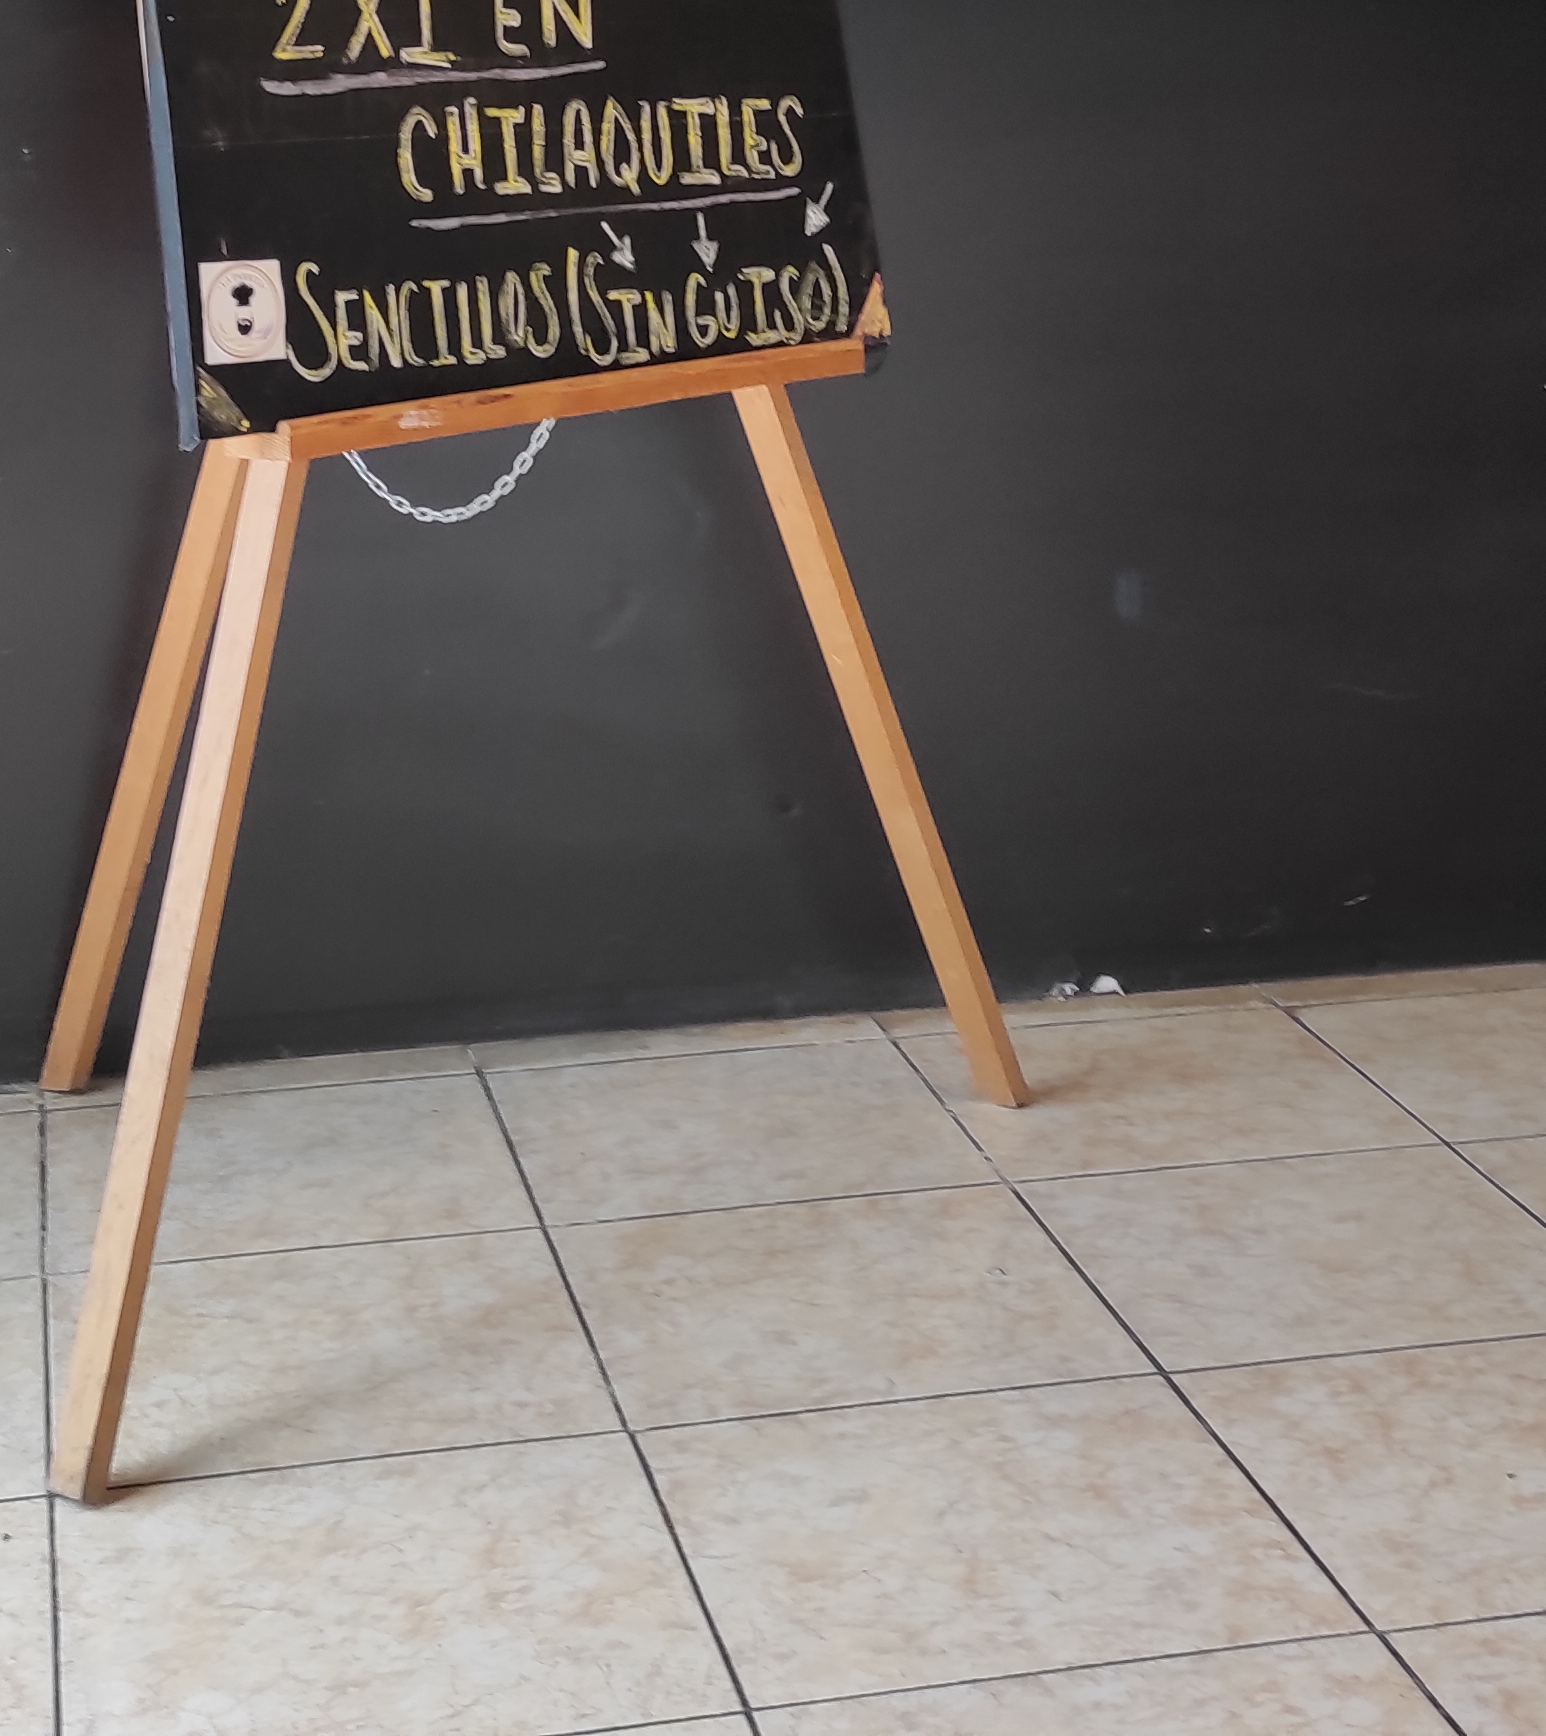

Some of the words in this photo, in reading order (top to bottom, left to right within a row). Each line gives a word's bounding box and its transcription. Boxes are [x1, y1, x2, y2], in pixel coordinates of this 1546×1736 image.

[396, 94, 805, 203] CHILAQUILES
[286, 260, 561, 383] SENCILLOS
[566, 246, 678, 366] (SIN
[683, 242, 851, 350] GUISO)
